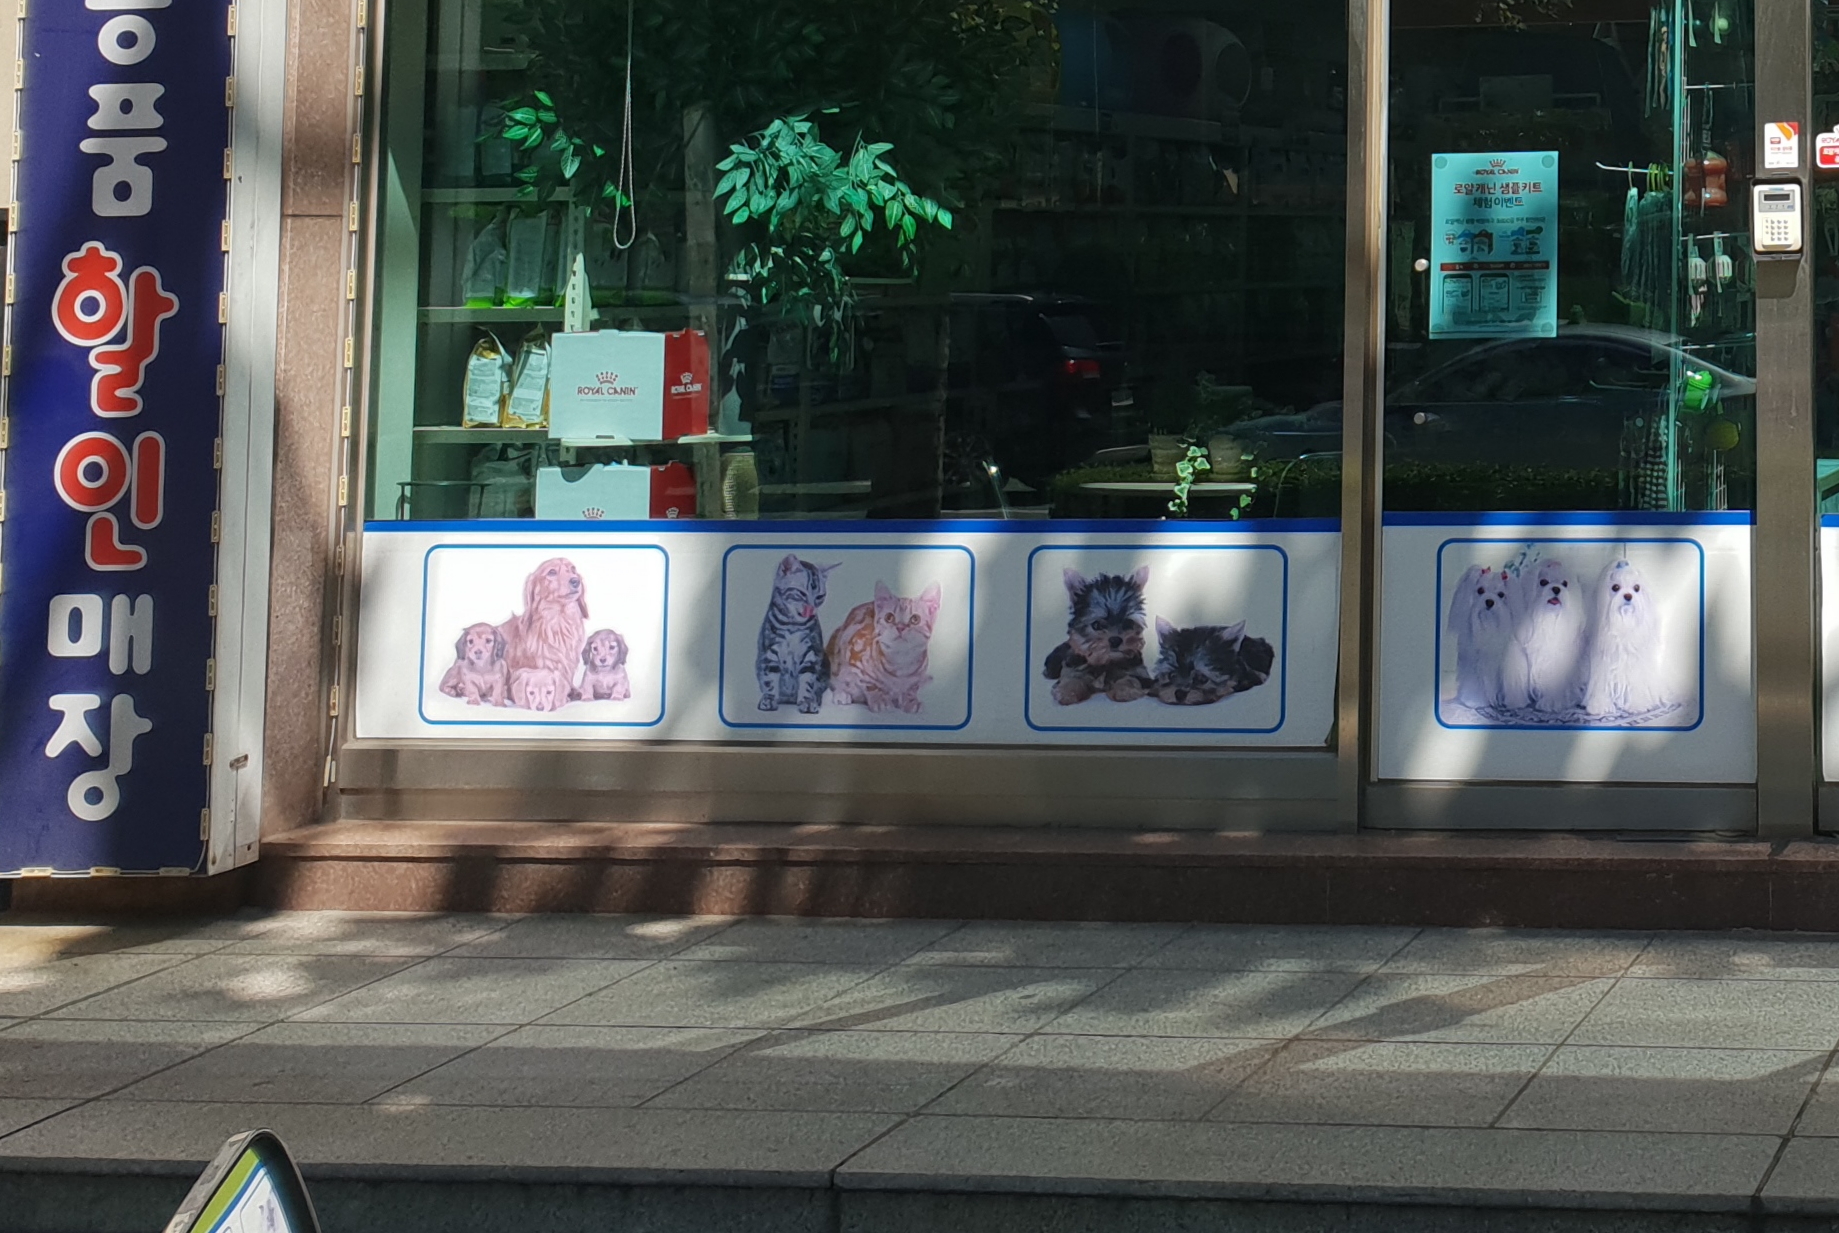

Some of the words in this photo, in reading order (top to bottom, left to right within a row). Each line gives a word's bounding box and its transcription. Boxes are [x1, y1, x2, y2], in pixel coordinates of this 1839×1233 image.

[1453, 182, 1497, 196] 로얄캐닌
[1499, 181, 1544, 195] 샘플키트
[577, 386, 605, 396] ROYAL
[606, 386, 637, 396] CANIN
